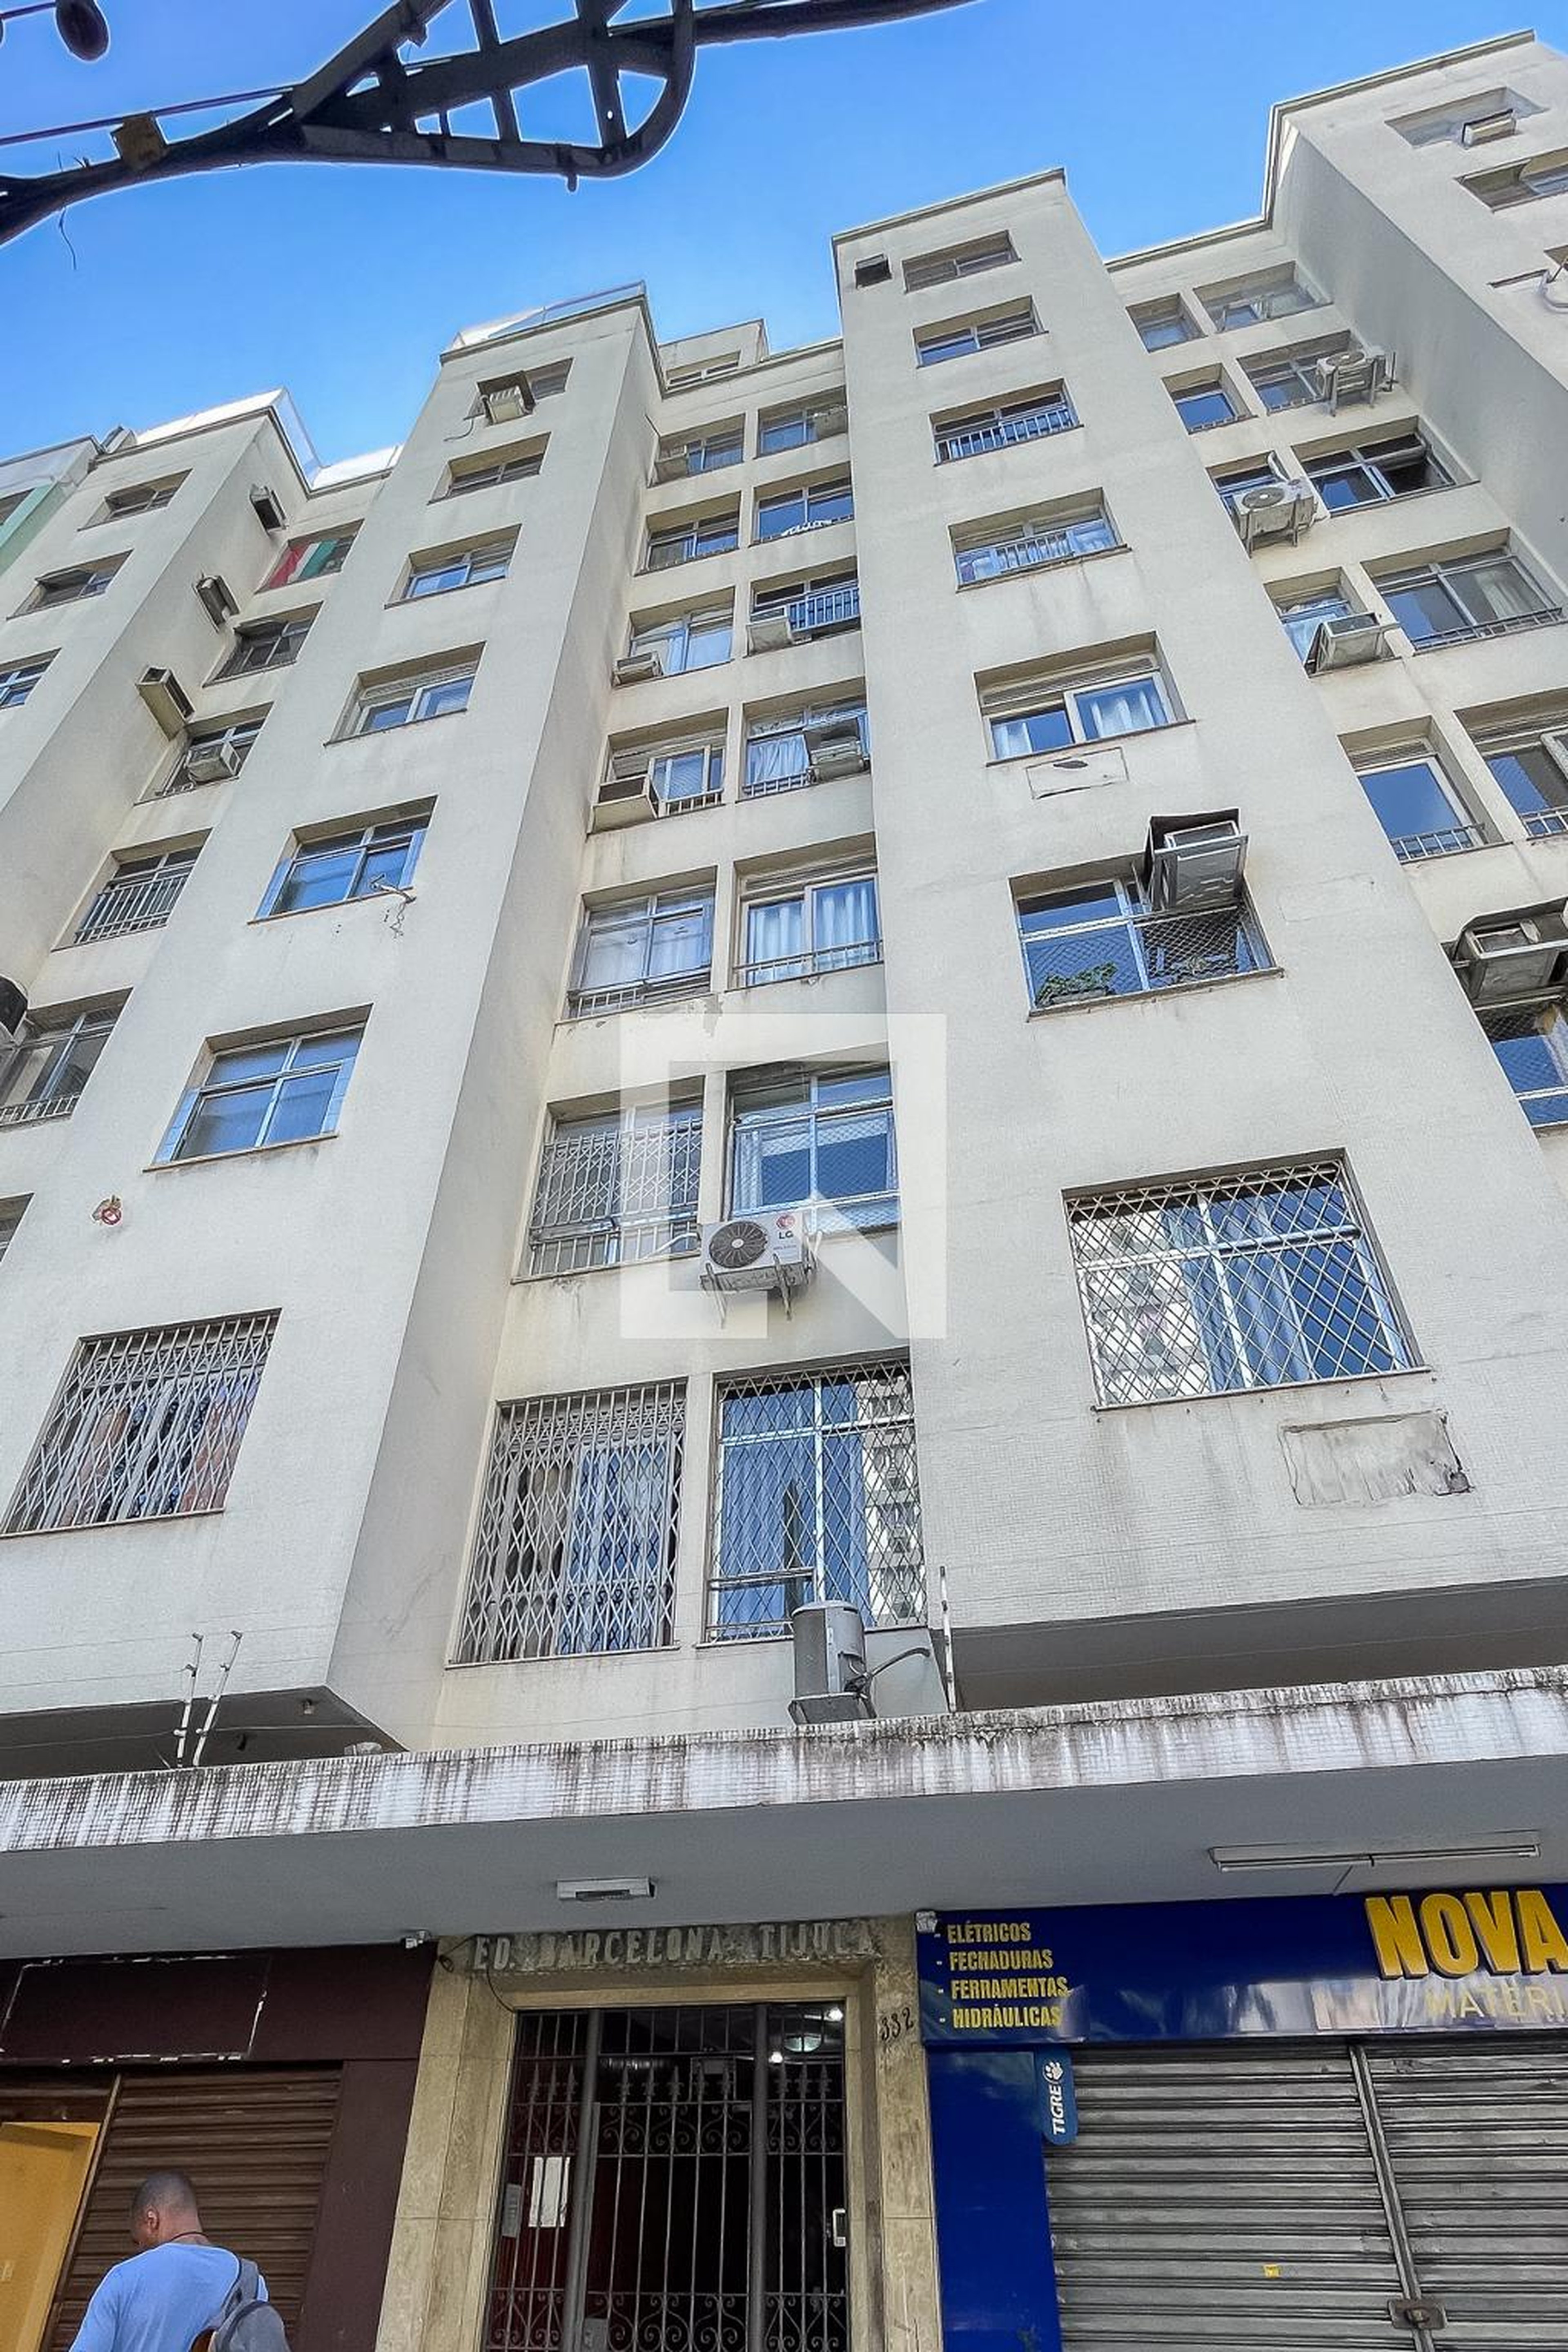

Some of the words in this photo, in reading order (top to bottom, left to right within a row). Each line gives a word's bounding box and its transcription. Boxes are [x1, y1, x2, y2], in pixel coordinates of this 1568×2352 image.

[779, 1230, 794, 1239] LG
[947, 1920, 1031, 1944] ELÉTRICOS
[1365, 1890, 1568, 1980] NOVA
[949, 1949, 1054, 1971] FECHADURAS
[951, 1977, 1069, 1999] FERRAMENTAS
[878, 2007, 914, 2041] 332
[953, 2003, 1062, 2028] HIDRÁULICAS
[1049, 2084, 1066, 2135] TIGRE
